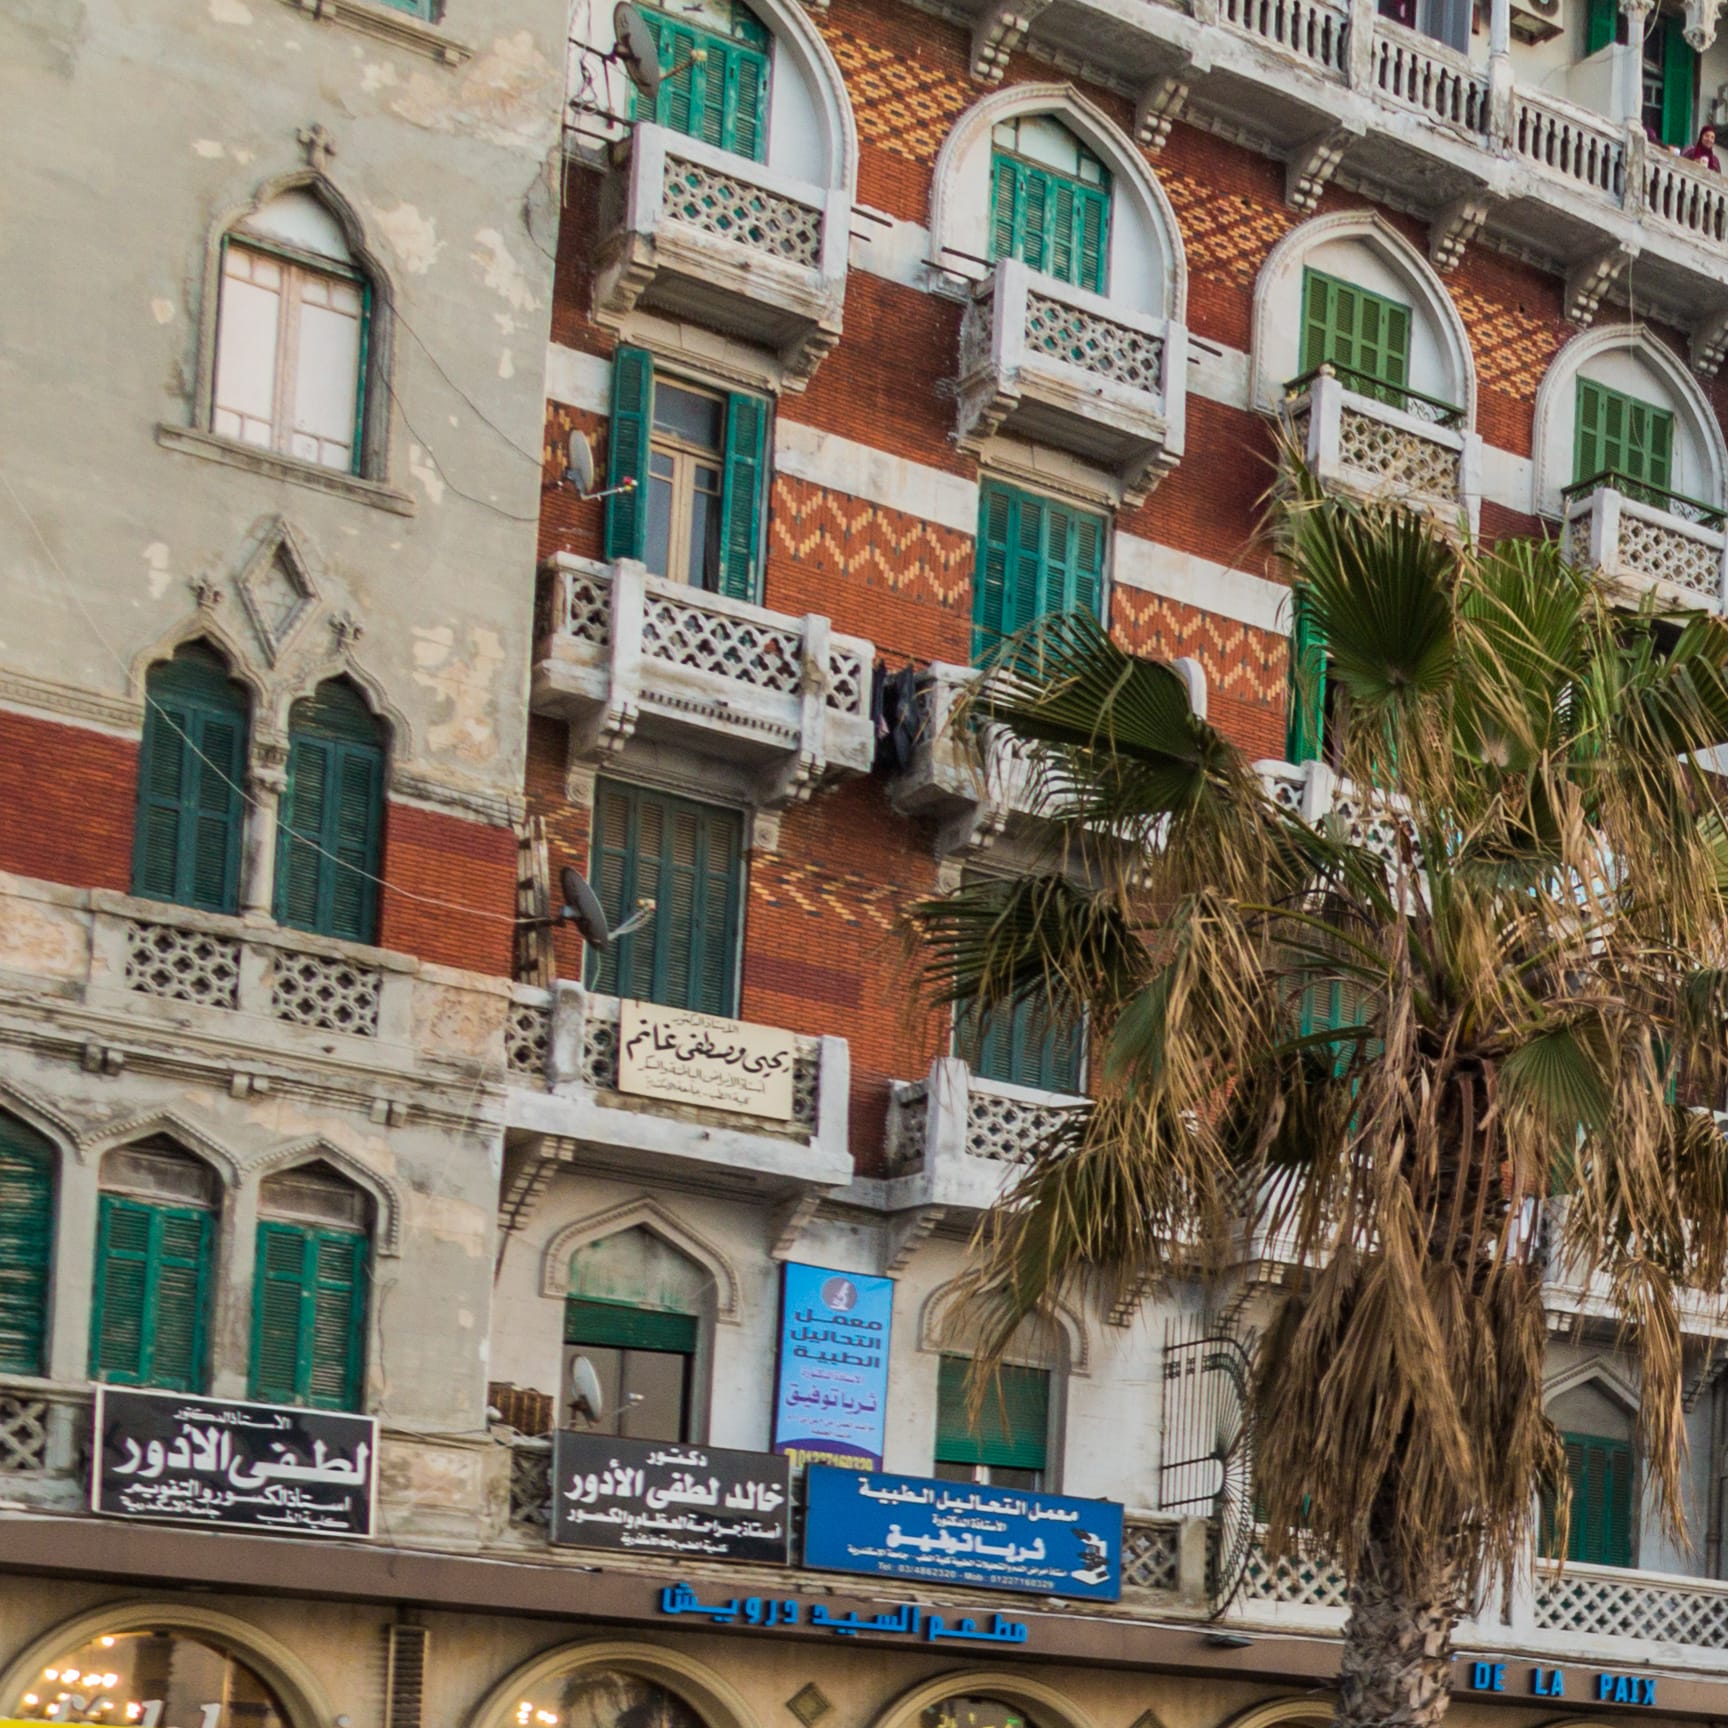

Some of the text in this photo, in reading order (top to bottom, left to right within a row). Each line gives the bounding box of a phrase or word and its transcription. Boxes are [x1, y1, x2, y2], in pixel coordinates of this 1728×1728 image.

[626, 1019, 676, 1062] غانم
[794, 1308, 883, 1331] معمل
[790, 1327, 881, 1350] التحاليل
[793, 1345, 881, 1368] الطبية
[785, 1383, 877, 1415] ثريا توفيق
[646, 1448, 708, 1467] دكتور
[564, 1459, 645, 1504] الأدور
[725, 1481, 785, 1512] خالد
[857, 1477, 1079, 1522] معمل التحاليل الطبية
[886, 1524, 1046, 1562] ثريا توفيق
[660, 1581, 1029, 1643] مطعم السيد درويش
[1474, 1661, 1658, 1706] DE LA PAIX
